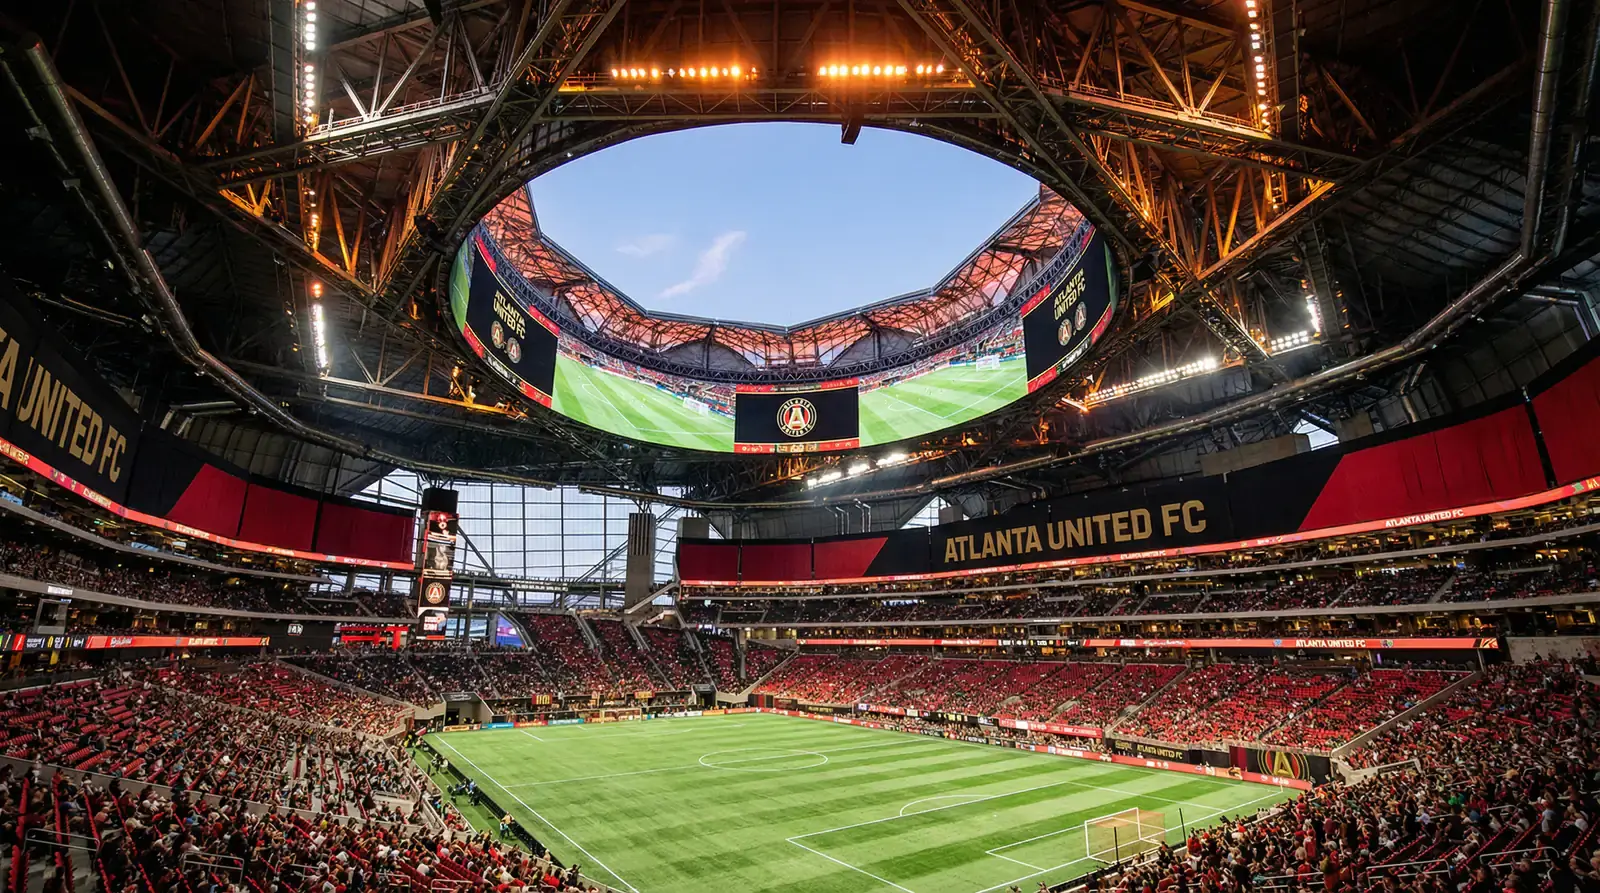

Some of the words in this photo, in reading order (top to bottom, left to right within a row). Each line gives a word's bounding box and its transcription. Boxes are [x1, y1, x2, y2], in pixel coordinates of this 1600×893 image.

[1054, 289, 1077, 321] UNITED
[1077, 276, 1086, 297] FC
[493, 297, 516, 331] UNITED
[516, 323, 526, 340] FC
[16, 356, 104, 466] UNITED
[98, 425, 127, 483] FC
[944, 525, 1043, 563] ATLANTA
[1047, 508, 1153, 550] UNITED
[1161, 499, 1207, 537] FC
[1385, 515, 1421, 528] ATLANTA
[1421, 511, 1451, 522] UNITED
[1452, 509, 1464, 518] FC
[1296, 639, 1327, 648] ATLANTA
[1327, 639, 1354, 648] UNITED
[1355, 639, 1366, 648] FC
[1137, 744, 1157, 755] ATLANTA
[1176, 751, 1183, 760] FC
[1273, 751, 1296, 779] A
